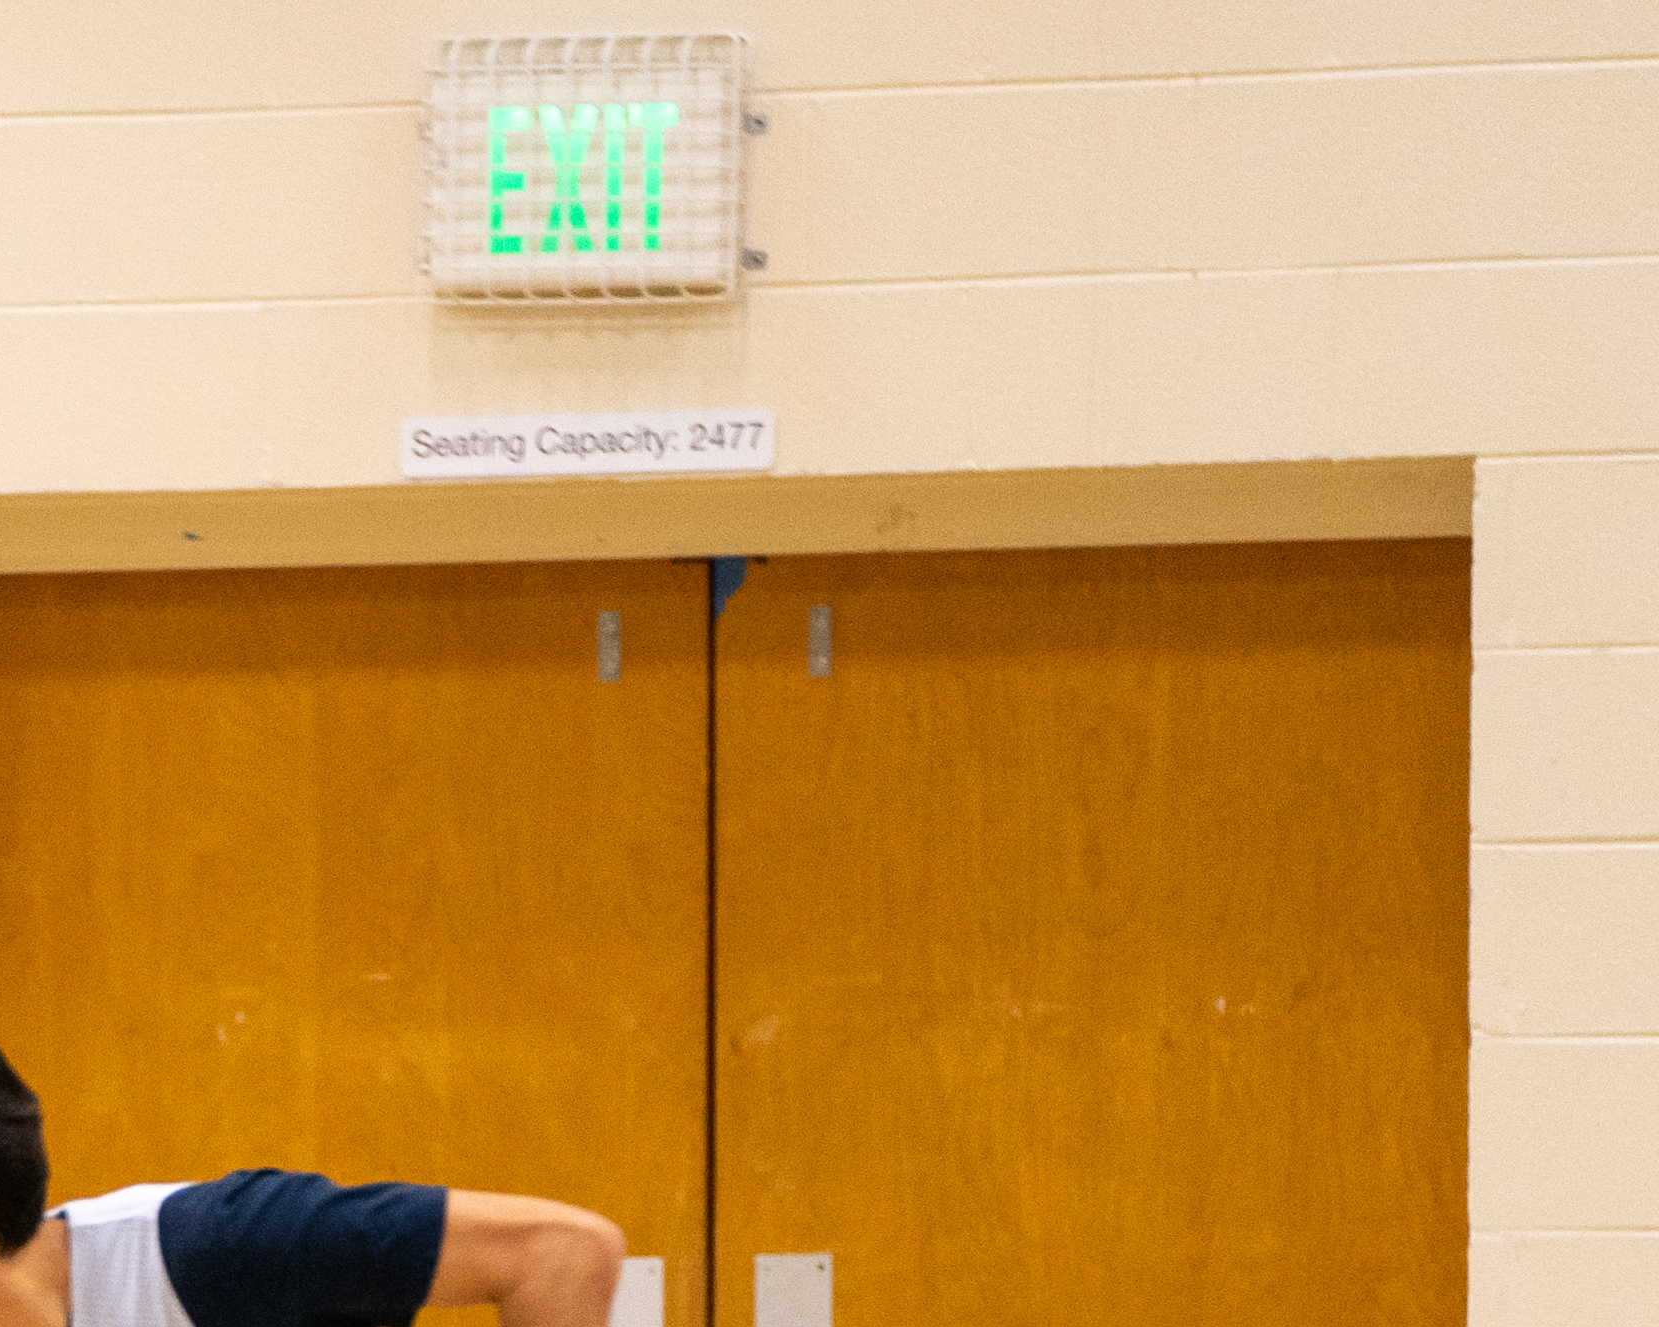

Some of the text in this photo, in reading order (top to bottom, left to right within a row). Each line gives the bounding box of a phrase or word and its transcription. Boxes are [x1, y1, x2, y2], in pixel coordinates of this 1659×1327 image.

[489, 103, 680, 254] EXIT
[411, 421, 764, 462] Seating Capacity: 2477
